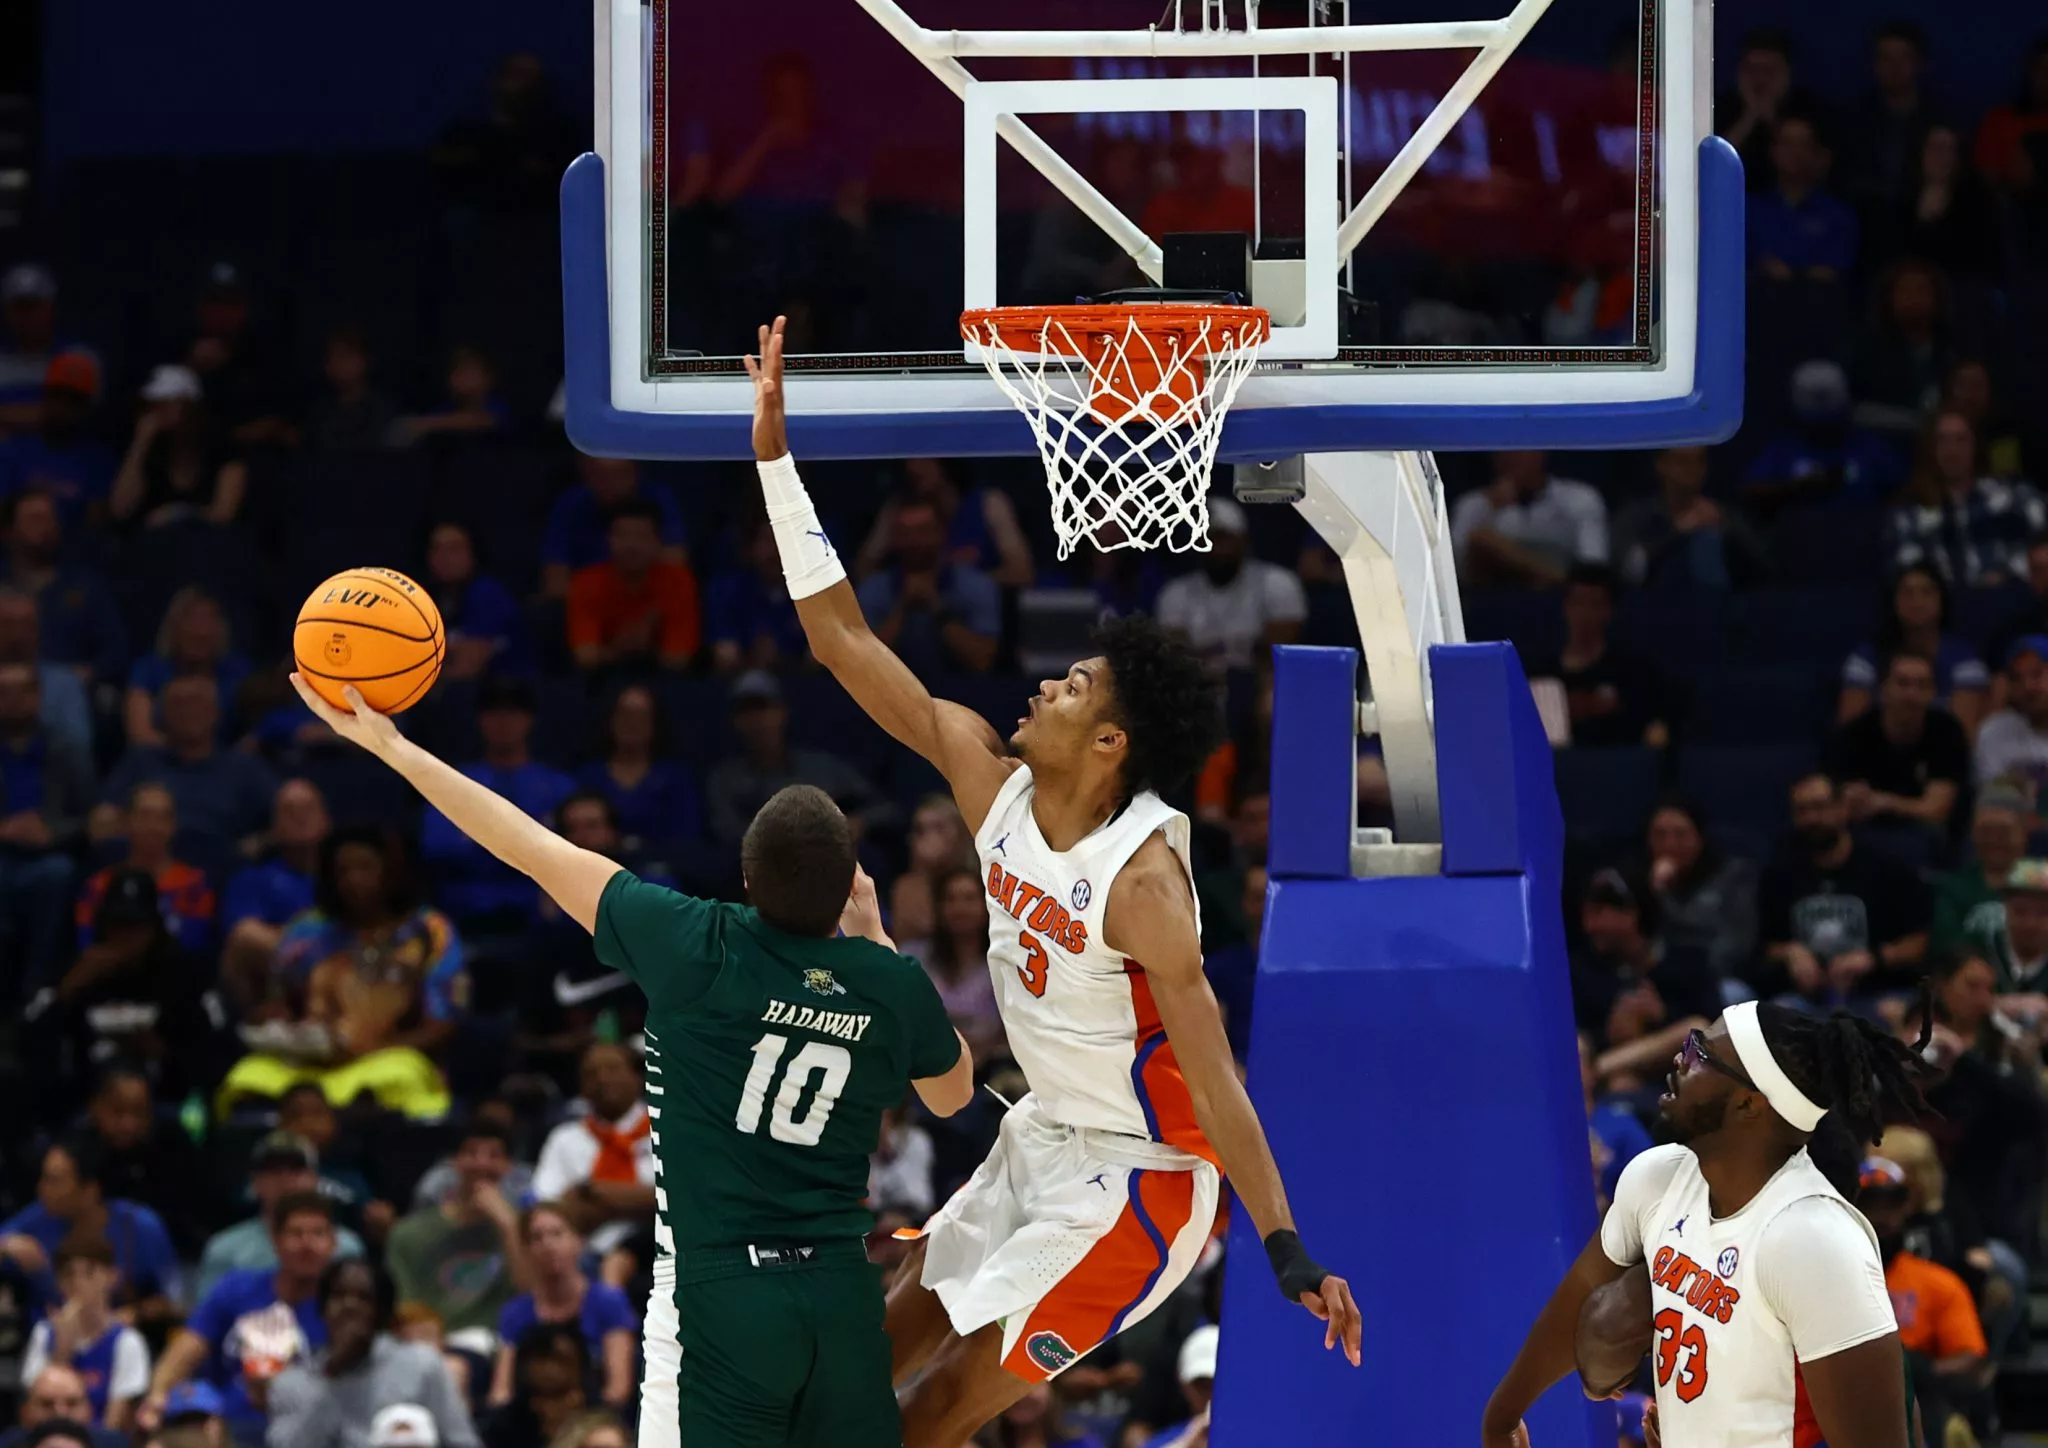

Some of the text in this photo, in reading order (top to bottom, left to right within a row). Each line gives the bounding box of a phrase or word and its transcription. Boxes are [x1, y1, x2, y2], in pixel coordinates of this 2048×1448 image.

[323, 588, 380, 608] EVO
[988, 862, 1088, 954] GATORS
[1016, 930, 1049, 998] 3
[761, 999, 871, 1041] HADAWAY
[735, 1033, 851, 1146] 10
[1652, 1245, 1740, 1324] GATORS
[1655, 1307, 1708, 1404] 33
